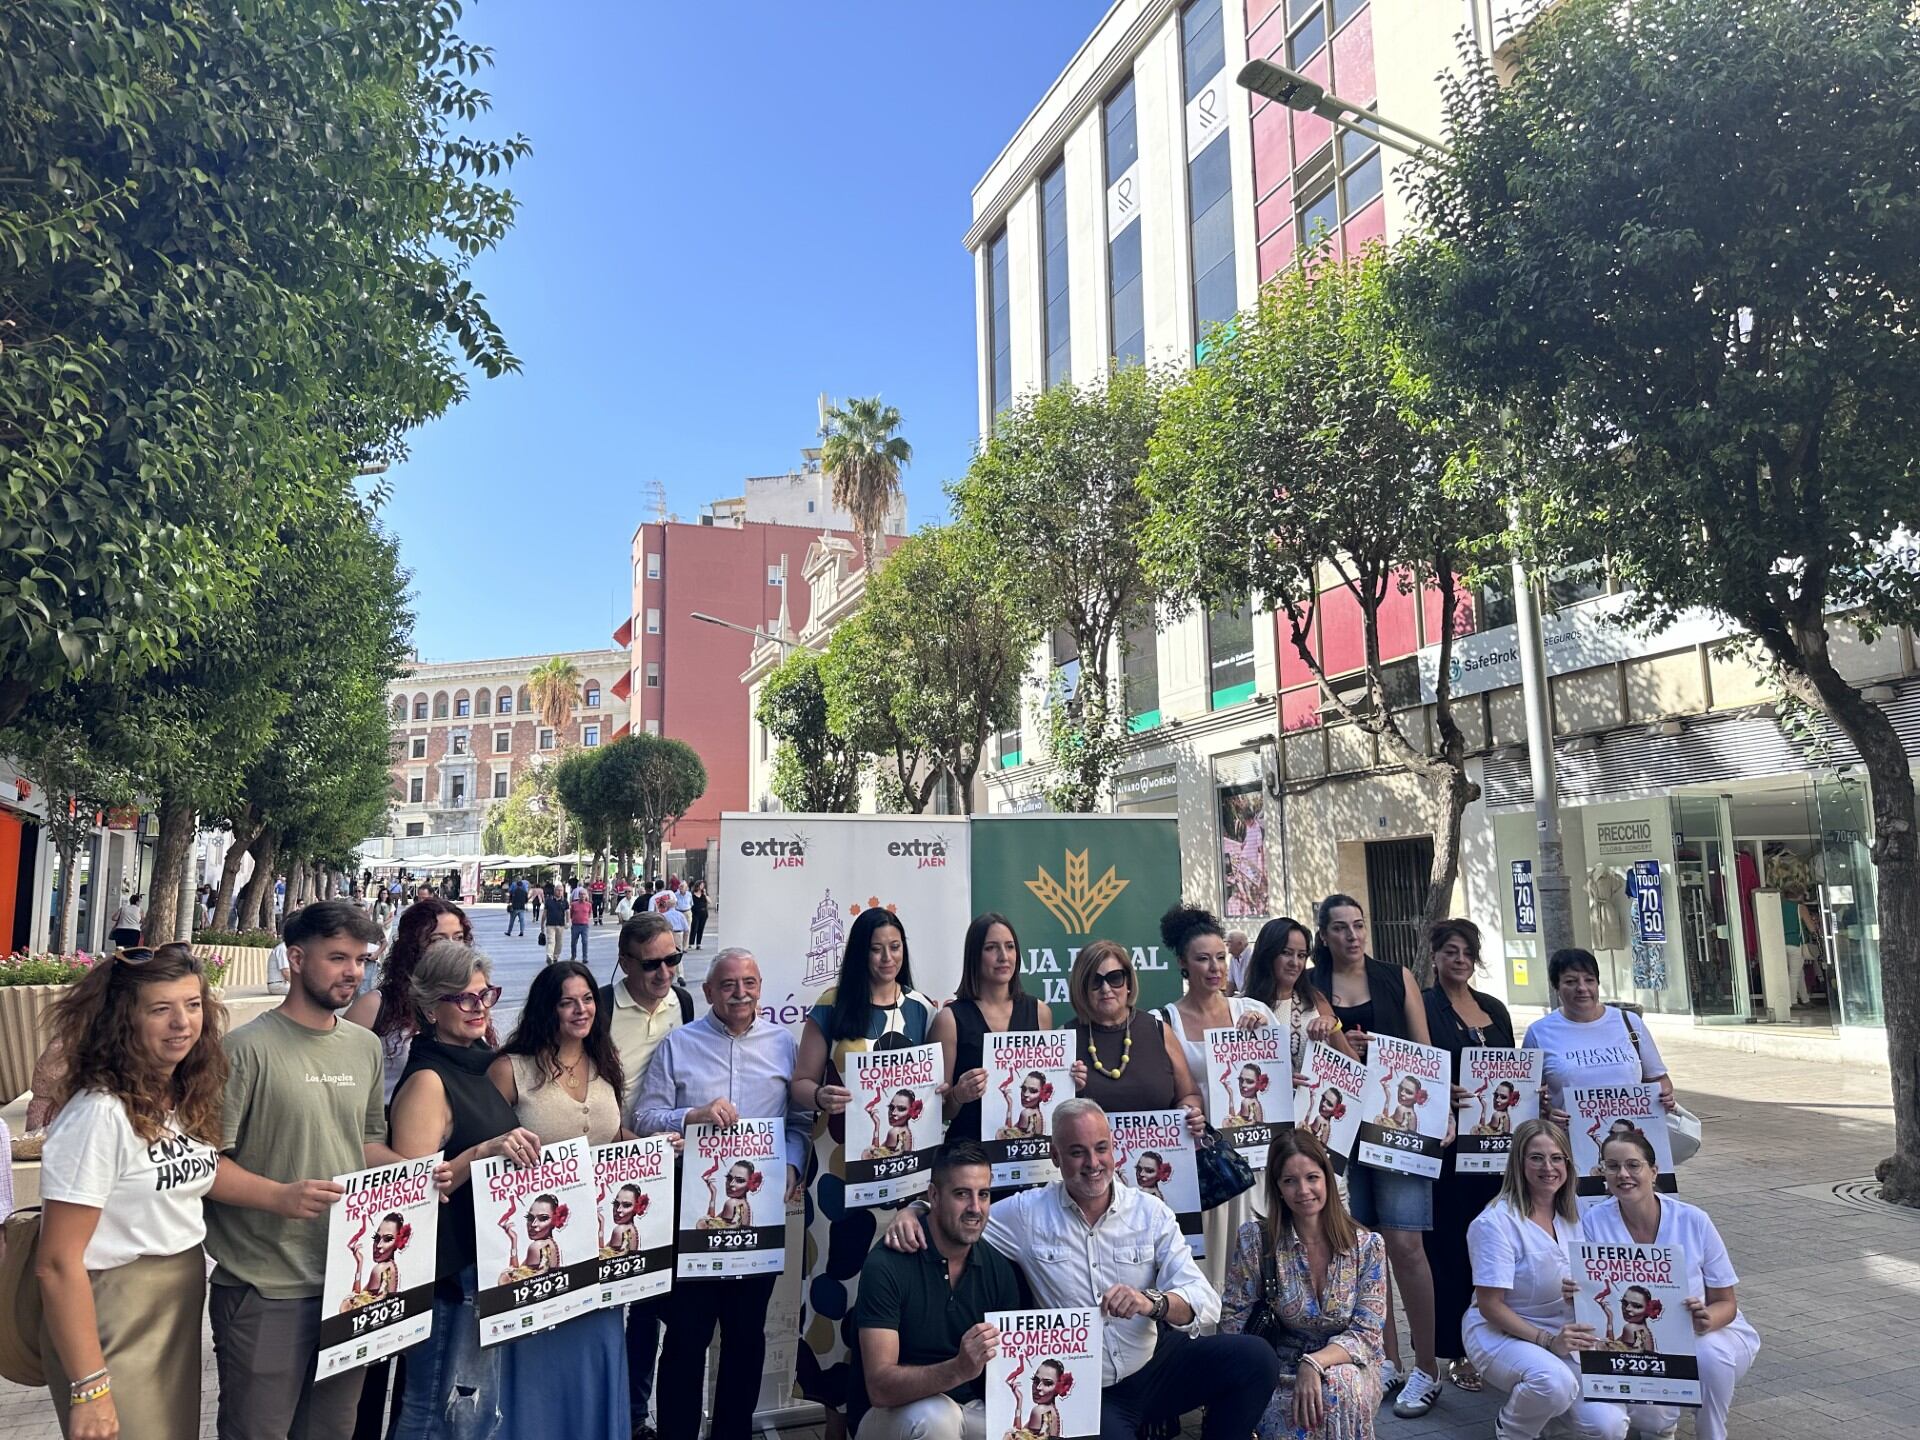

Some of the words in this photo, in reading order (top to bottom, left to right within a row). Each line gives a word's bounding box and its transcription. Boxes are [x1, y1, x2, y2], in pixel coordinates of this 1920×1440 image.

[1544, 630, 1582, 646] SEGUROS
[1464, 648, 1518, 672] SafeBrok
[1150, 775, 1176, 788] MORENO
[1598, 824, 1650, 842] PRECCHIO
[740, 838, 804, 856] extra
[888, 838, 945, 856] extra
[773, 854, 804, 870] JAÉN
[918, 854, 945, 870] JAÉN
[1513, 873, 1532, 883] TODO
[1637, 875, 1660, 886] TODO
[1639, 889, 1658, 912] 70
[1644, 912, 1662, 932] 50
[994, 1037, 1001, 1048] II
[1007, 1035, 1046, 1048] FERIA
[1051, 1034, 1066, 1046] DE
[1211, 1032, 1217, 1044] II
[1222, 1030, 1258, 1042] FERIA
[1262, 1029, 1278, 1040] DE
[995, 1047, 1064, 1060] COMERCIO
[1213, 1041, 1277, 1054] COMERCIO
[1377, 1037, 1385, 1048] II
[1389, 1040, 1422, 1058] FERIA
[1427, 1049, 1442, 1062] DE
[858, 1057, 866, 1068] II
[873, 1052, 914, 1067] FERIA
[919, 1048, 933, 1063] DE
[1314, 1043, 1320, 1054] II
[1322, 1048, 1350, 1072] FERIA
[1354, 1065, 1368, 1080] DE
[1379, 1048, 1440, 1070] COMERCIO
[1470, 1051, 1477, 1061] II
[1482, 1051, 1515, 1061] FERIA
[1520, 1052, 1535, 1062] DE
[860, 1061, 932, 1080] COMERCIO
[1313, 1055, 1363, 1088] COMERCIO
[1471, 1061, 1532, 1070] COMERCIO
[305, 1073, 319, 1082] Los
[320, 1073, 353, 1083] Angeles
[1574, 1090, 1583, 1100] II
[1588, 1088, 1629, 1100] FERIA
[1633, 1086, 1651, 1097] DE
[1578, 1097, 1650, 1109] COMERCIO
[1116, 1115, 1158, 1128] FERIA
[1163, 1114, 1181, 1126] DE
[697, 1126, 706, 1137] II
[712, 1123, 754, 1136] FERIA
[759, 1122, 774, 1134] DE
[1111, 1126, 1180, 1140] OMERCIO
[699, 1134, 773, 1148] COMERCIO
[1480, 1140, 1512, 1149] 19-20-2
[598, 1144, 640, 1163] FERIA
[646, 1140, 663, 1154] DE
[486, 1162, 497, 1178] II
[559, 1143, 578, 1161] DE
[592, 1154, 661, 1176] OMERCIO
[156, 1150, 218, 1191] HAPPIN
[345, 1178, 357, 1195] II
[362, 1166, 408, 1190] FERIA
[413, 1160, 433, 1177] DE
[489, 1159, 578, 1190] COMERCIO
[346, 1175, 428, 1208] COMERCIO
[1581, 1246, 1592, 1258] II
[1598, 1247, 1646, 1260] FERIA
[1652, 1248, 1672, 1261] DE
[1585, 1259, 1671, 1273] COMERCIO
[1000, 1317, 1010, 1332] II
[1016, 1314, 1065, 1331] FERIA
[1071, 1313, 1090, 1328] DE
[1001, 1327, 1088, 1346] COMERCIO
